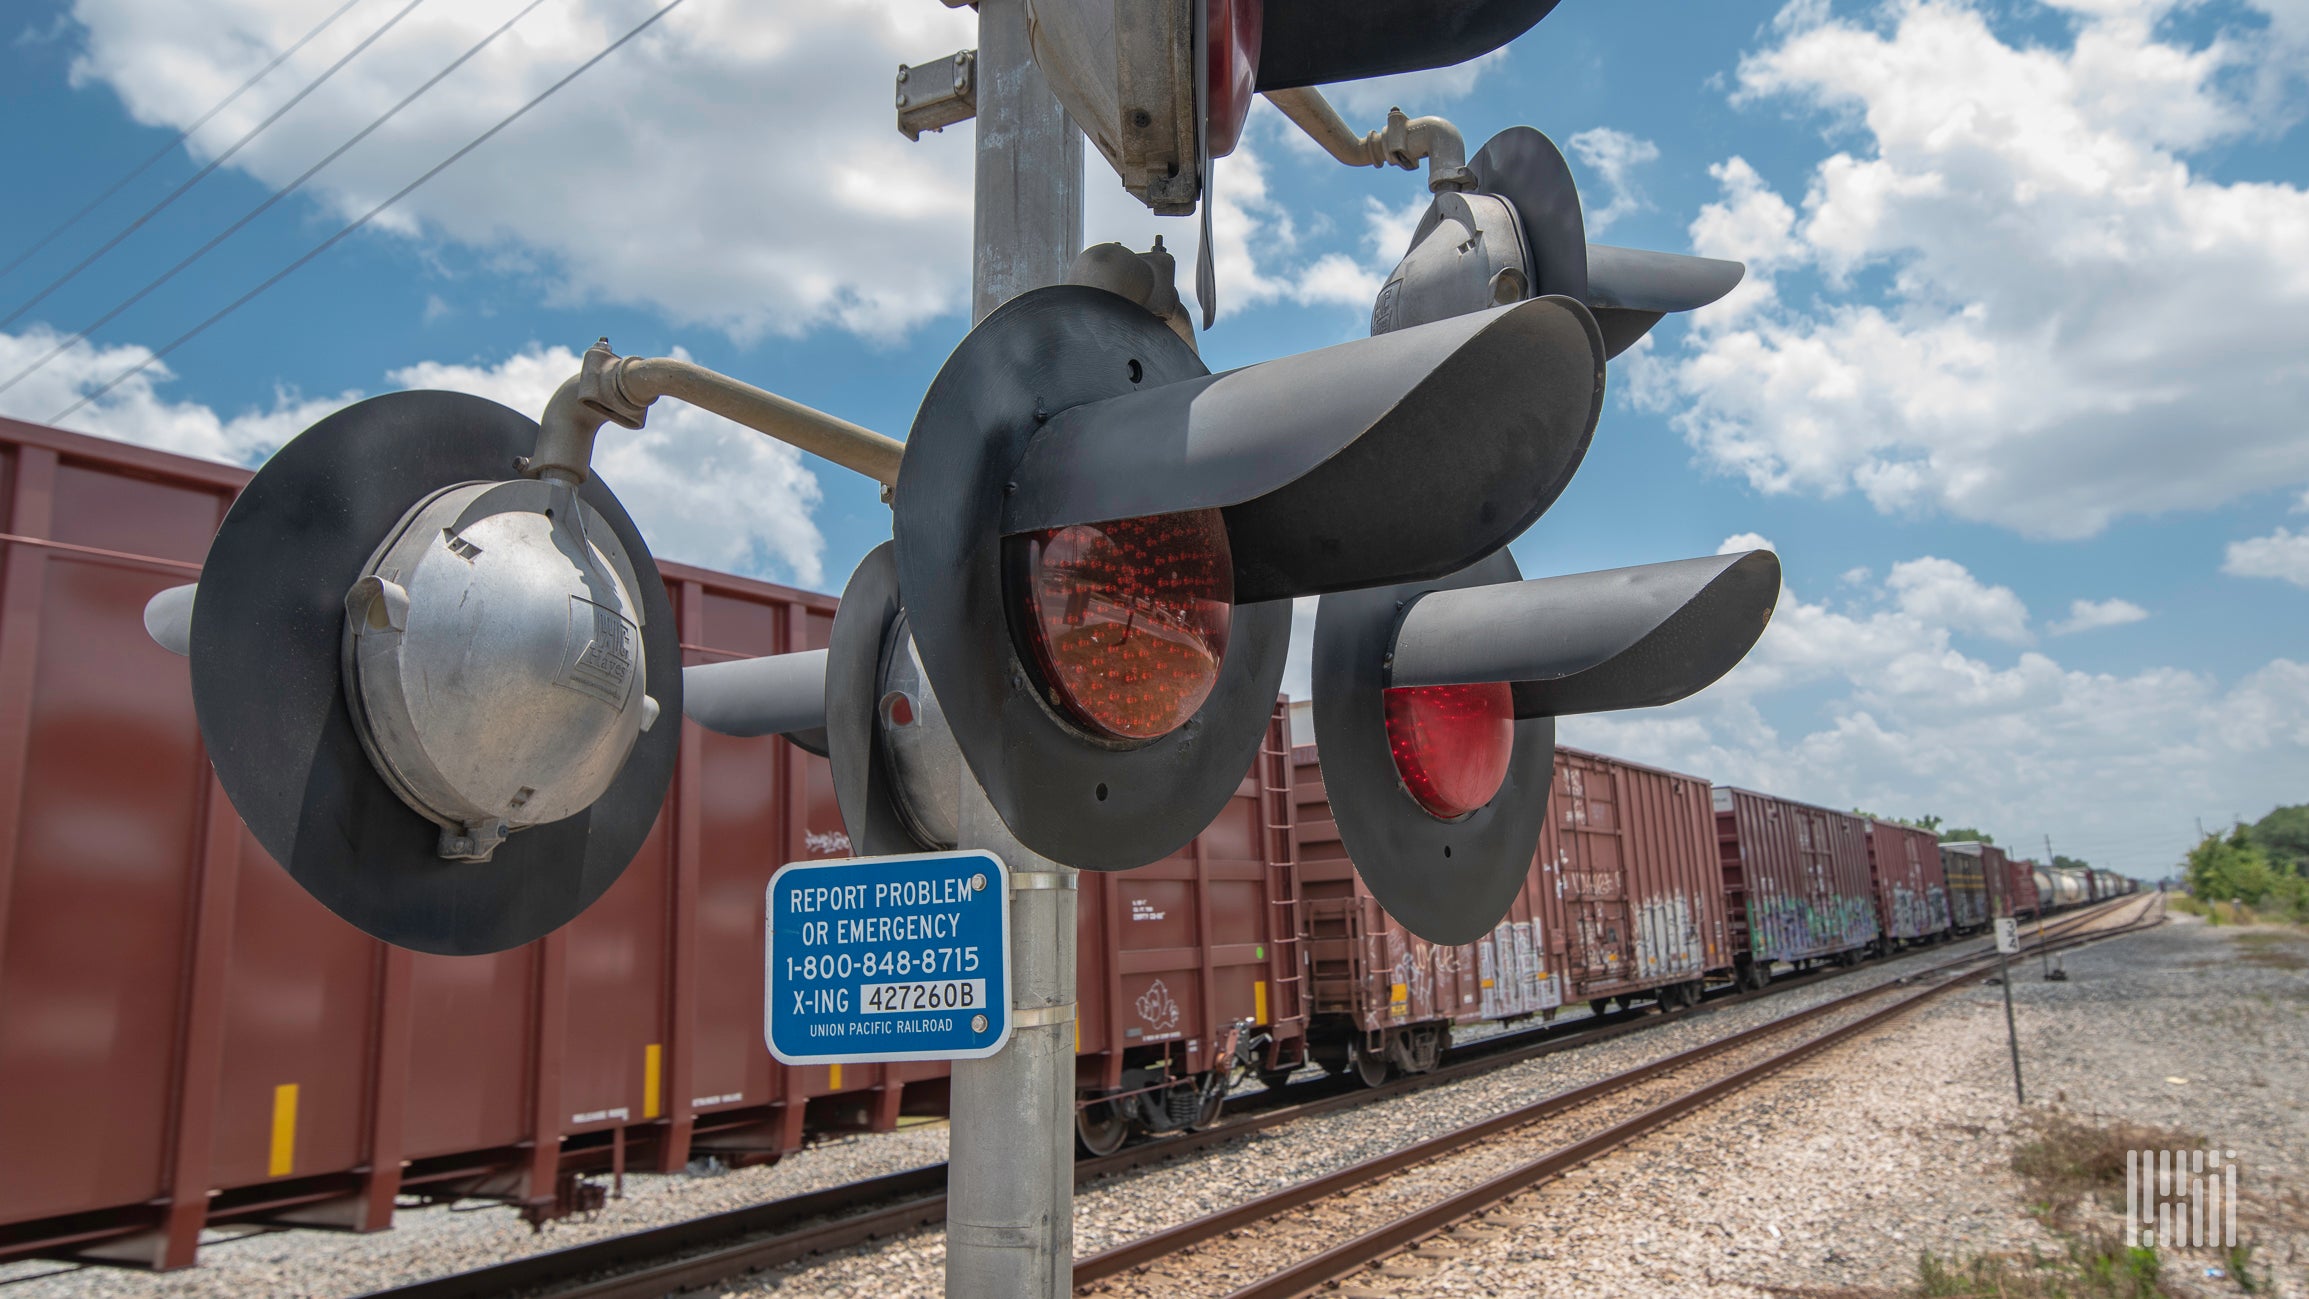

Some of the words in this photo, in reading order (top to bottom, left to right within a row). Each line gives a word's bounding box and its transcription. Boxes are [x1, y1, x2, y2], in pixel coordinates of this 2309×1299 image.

[790, 885, 867, 913] REPORT
[875, 878, 973, 908] PROBLEM
[802, 922, 829, 946] OR
[837, 913, 961, 944] EMERGENCY
[786, 946, 980, 981] 1-800-848-8715
[792, 988, 850, 1015] X-ING
[868, 982, 975, 1011] 427260B
[809, 1023, 845, 1037] UNION
[849, 1021, 892, 1035] PACIFIC
[896, 1018, 953, 1033] RAILROAD
